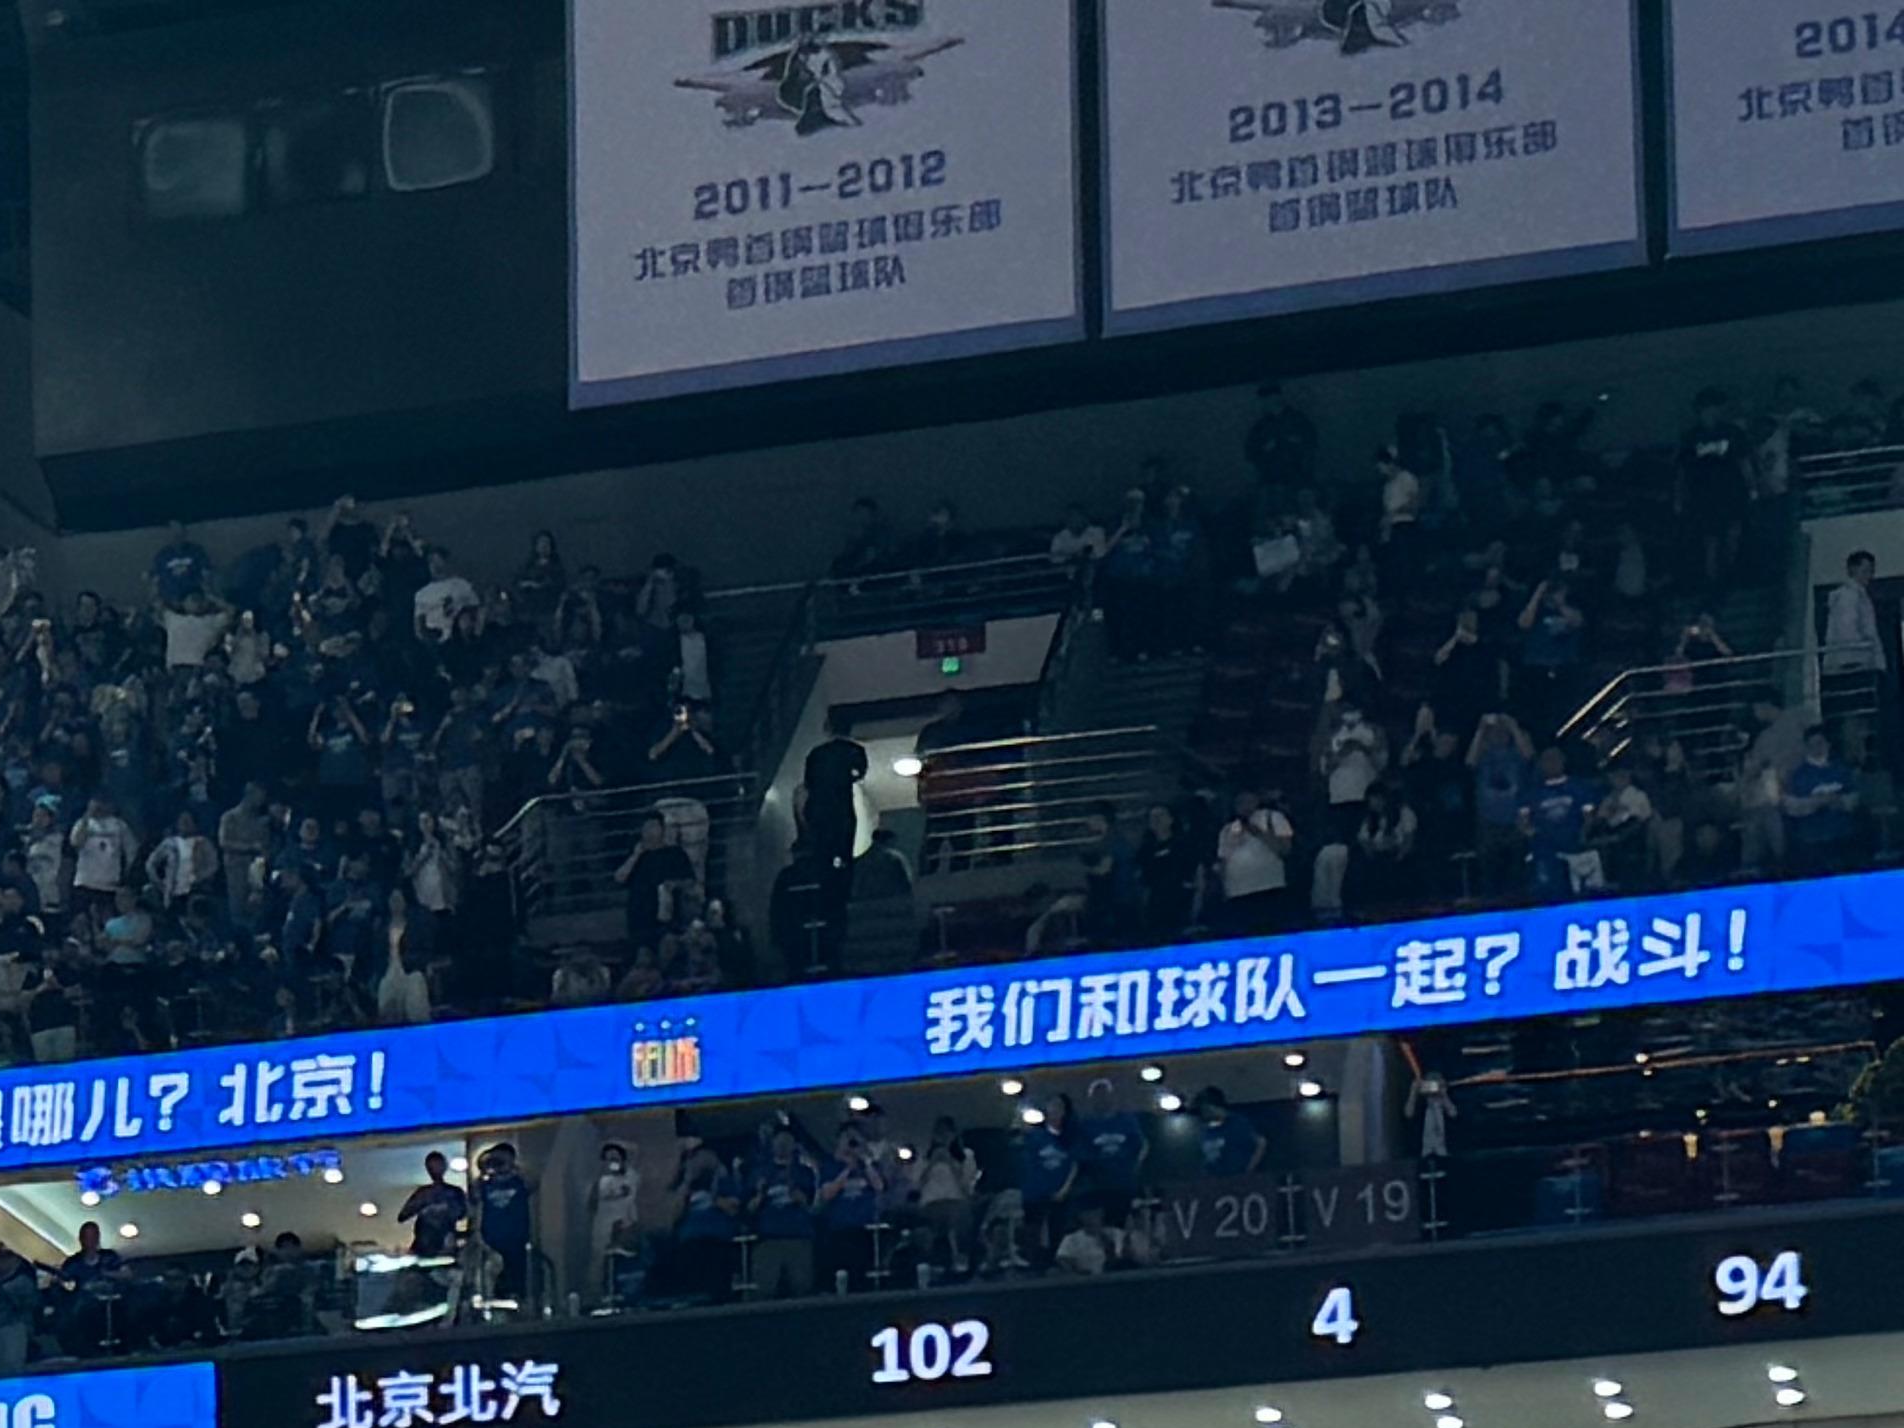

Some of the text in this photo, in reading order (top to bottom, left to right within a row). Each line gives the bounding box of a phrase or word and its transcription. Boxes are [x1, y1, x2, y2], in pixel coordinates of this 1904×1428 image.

[1173, 1192, 1270, 1241] V 20
[1312, 1179, 1412, 1227] V 19
[1713, 1250, 1808, 1318] 94
[1310, 1286, 1360, 1345] 4
[869, 1319, 993, 1384] 102
